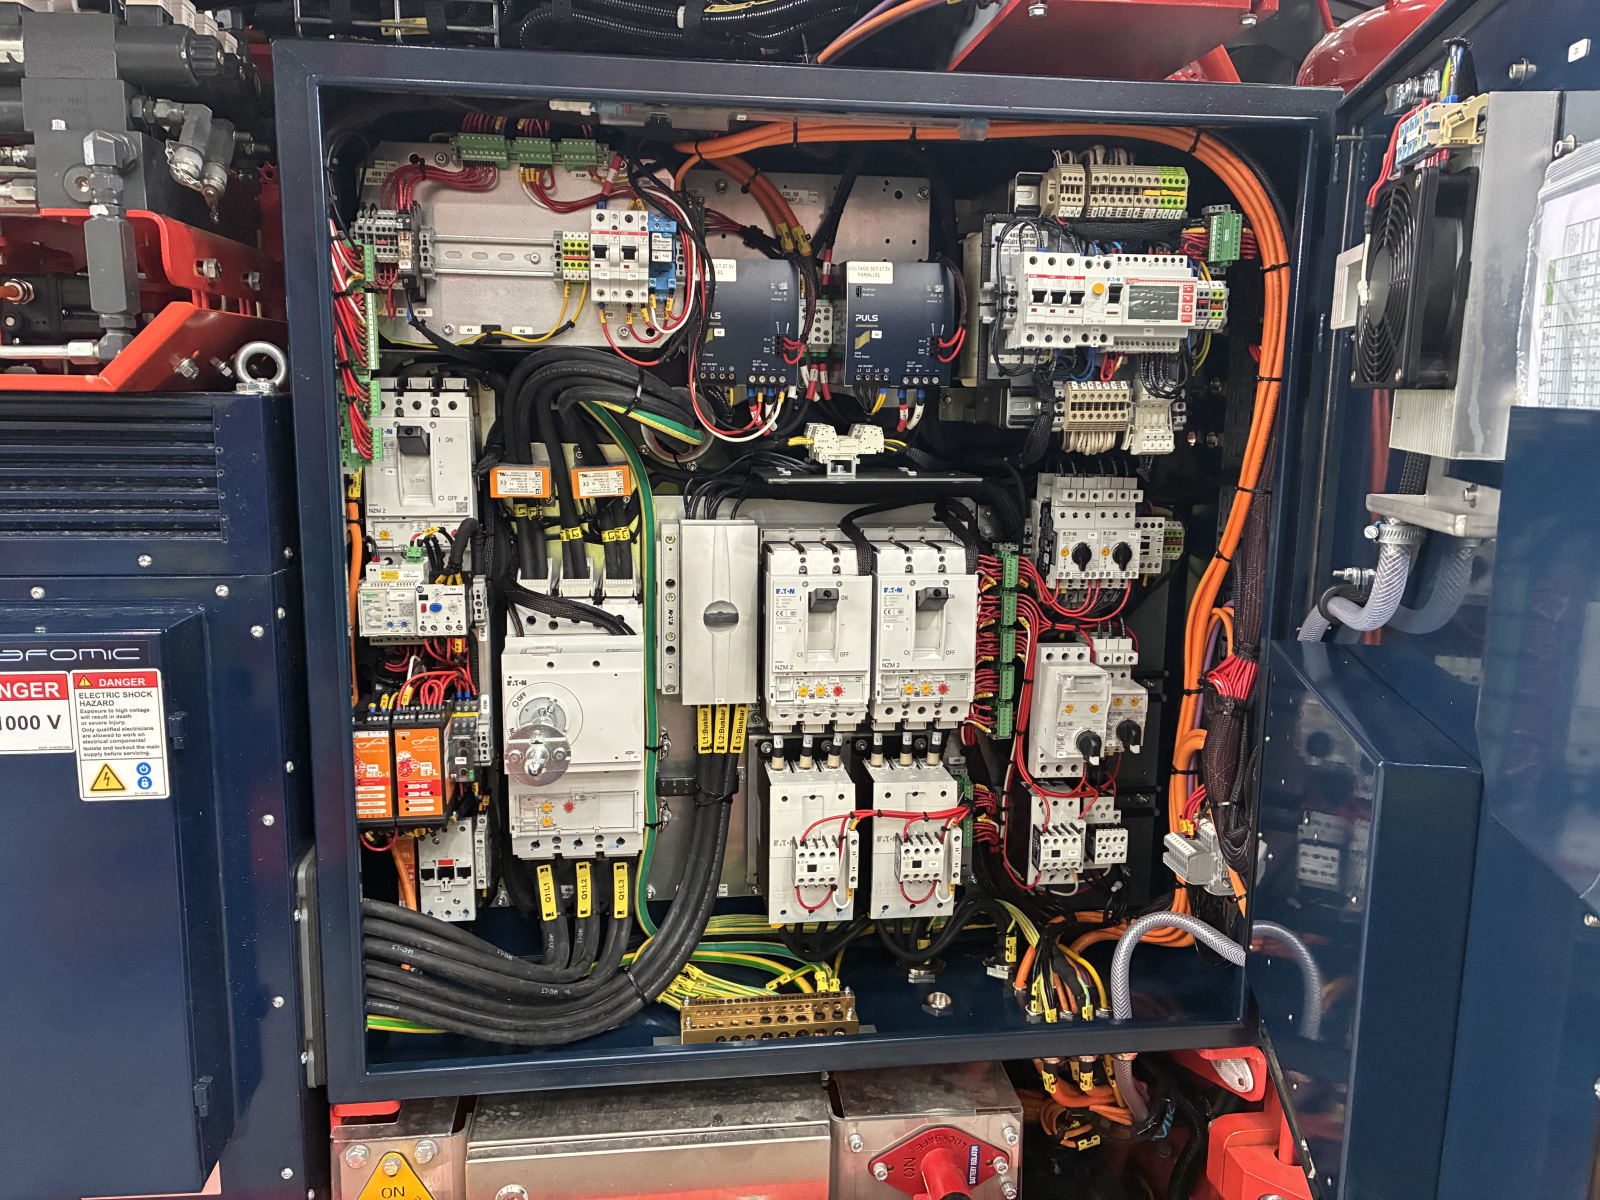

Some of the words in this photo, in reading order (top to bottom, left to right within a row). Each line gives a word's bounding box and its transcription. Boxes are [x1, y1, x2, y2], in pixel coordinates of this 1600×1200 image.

[855, 314, 879, 322] PULS
[98, 678, 146, 687] DANGER
[516, 691, 527, 701] OFF
[46, 714, 62, 729] V
[718, 708, 726, 744] L2:Busbar
[735, 709, 745, 744] L3:Busbar
[773, 839, 793, 847] EATO
[876, 835, 899, 843] EATO
[544, 882, 552, 903] Q1:L1
[904, 1157, 916, 1178] ON
[381, 1186, 405, 1199] ON
